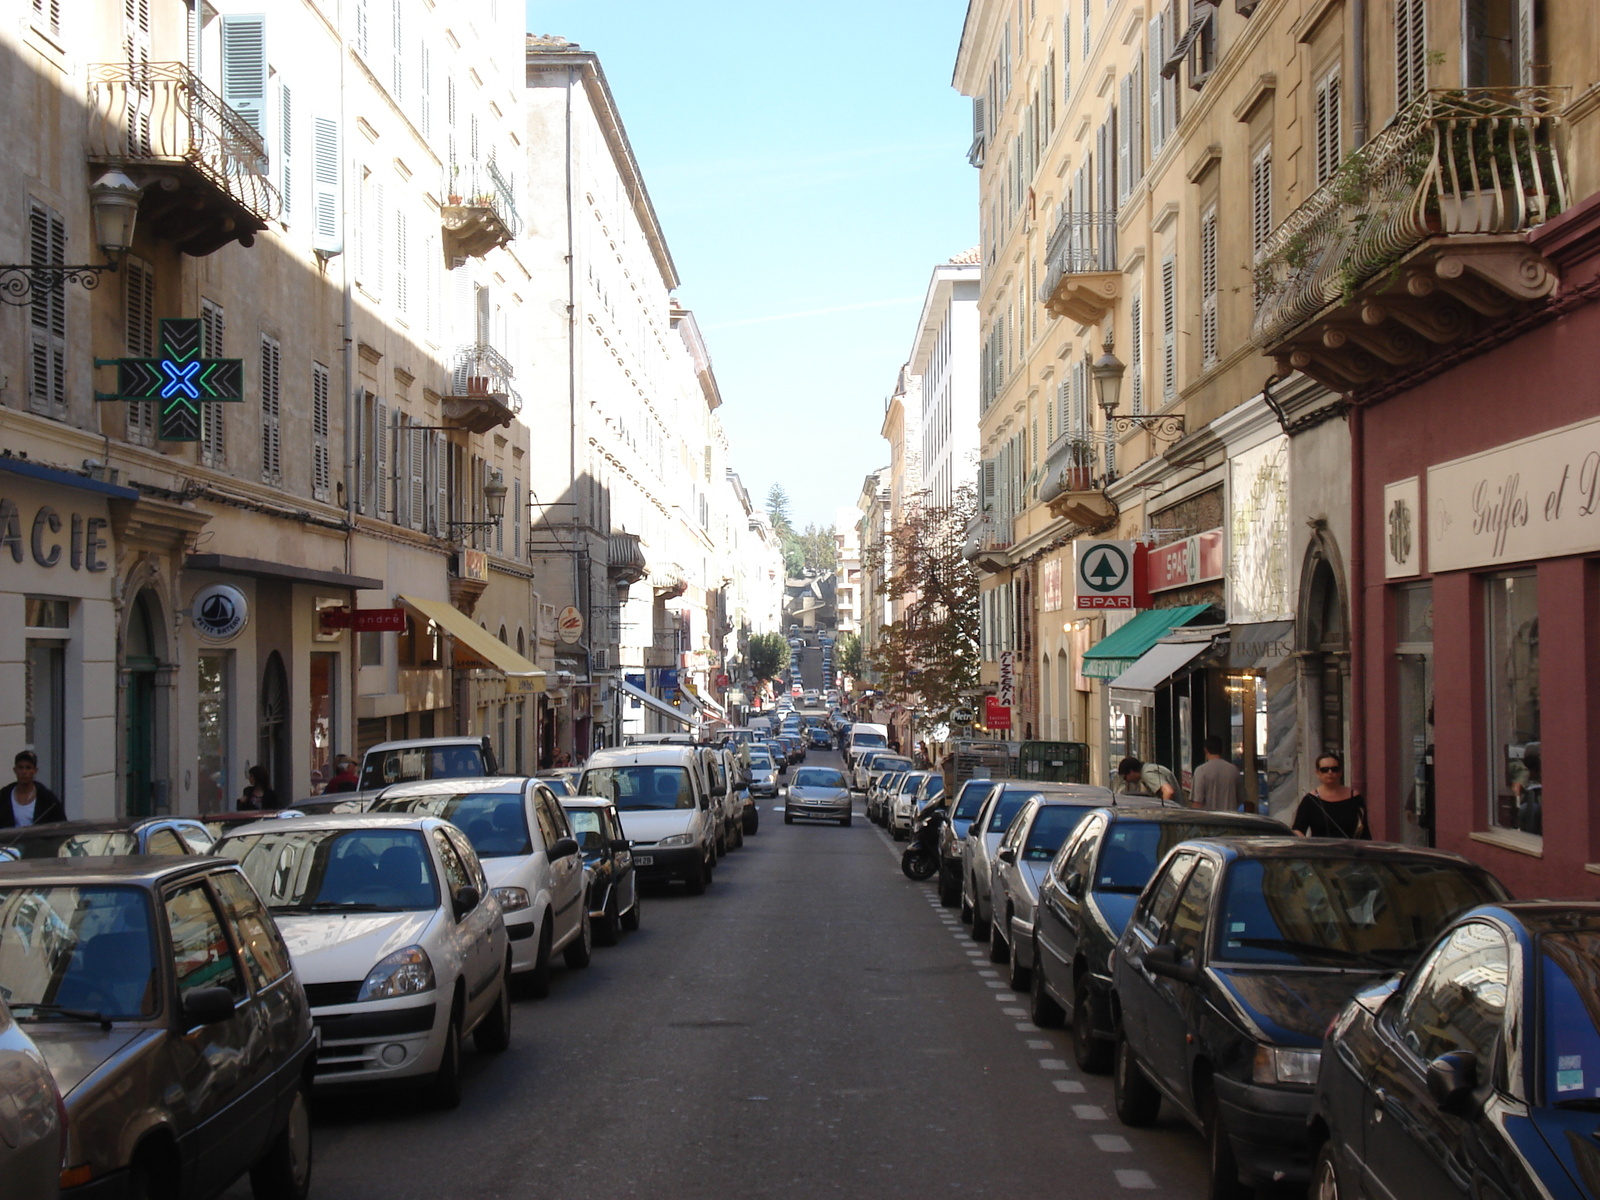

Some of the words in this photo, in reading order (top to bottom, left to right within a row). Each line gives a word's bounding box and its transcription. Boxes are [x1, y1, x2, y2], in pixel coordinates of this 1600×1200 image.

[1472, 472, 1530, 558] Griffes
[1545, 464, 1570, 522] et
[1166, 549, 1188, 581] SPAR
[1079, 597, 1130, 608] SPAR
[358, 613, 399, 625] andré
[1000, 652, 1012, 706] PIZZERIA
